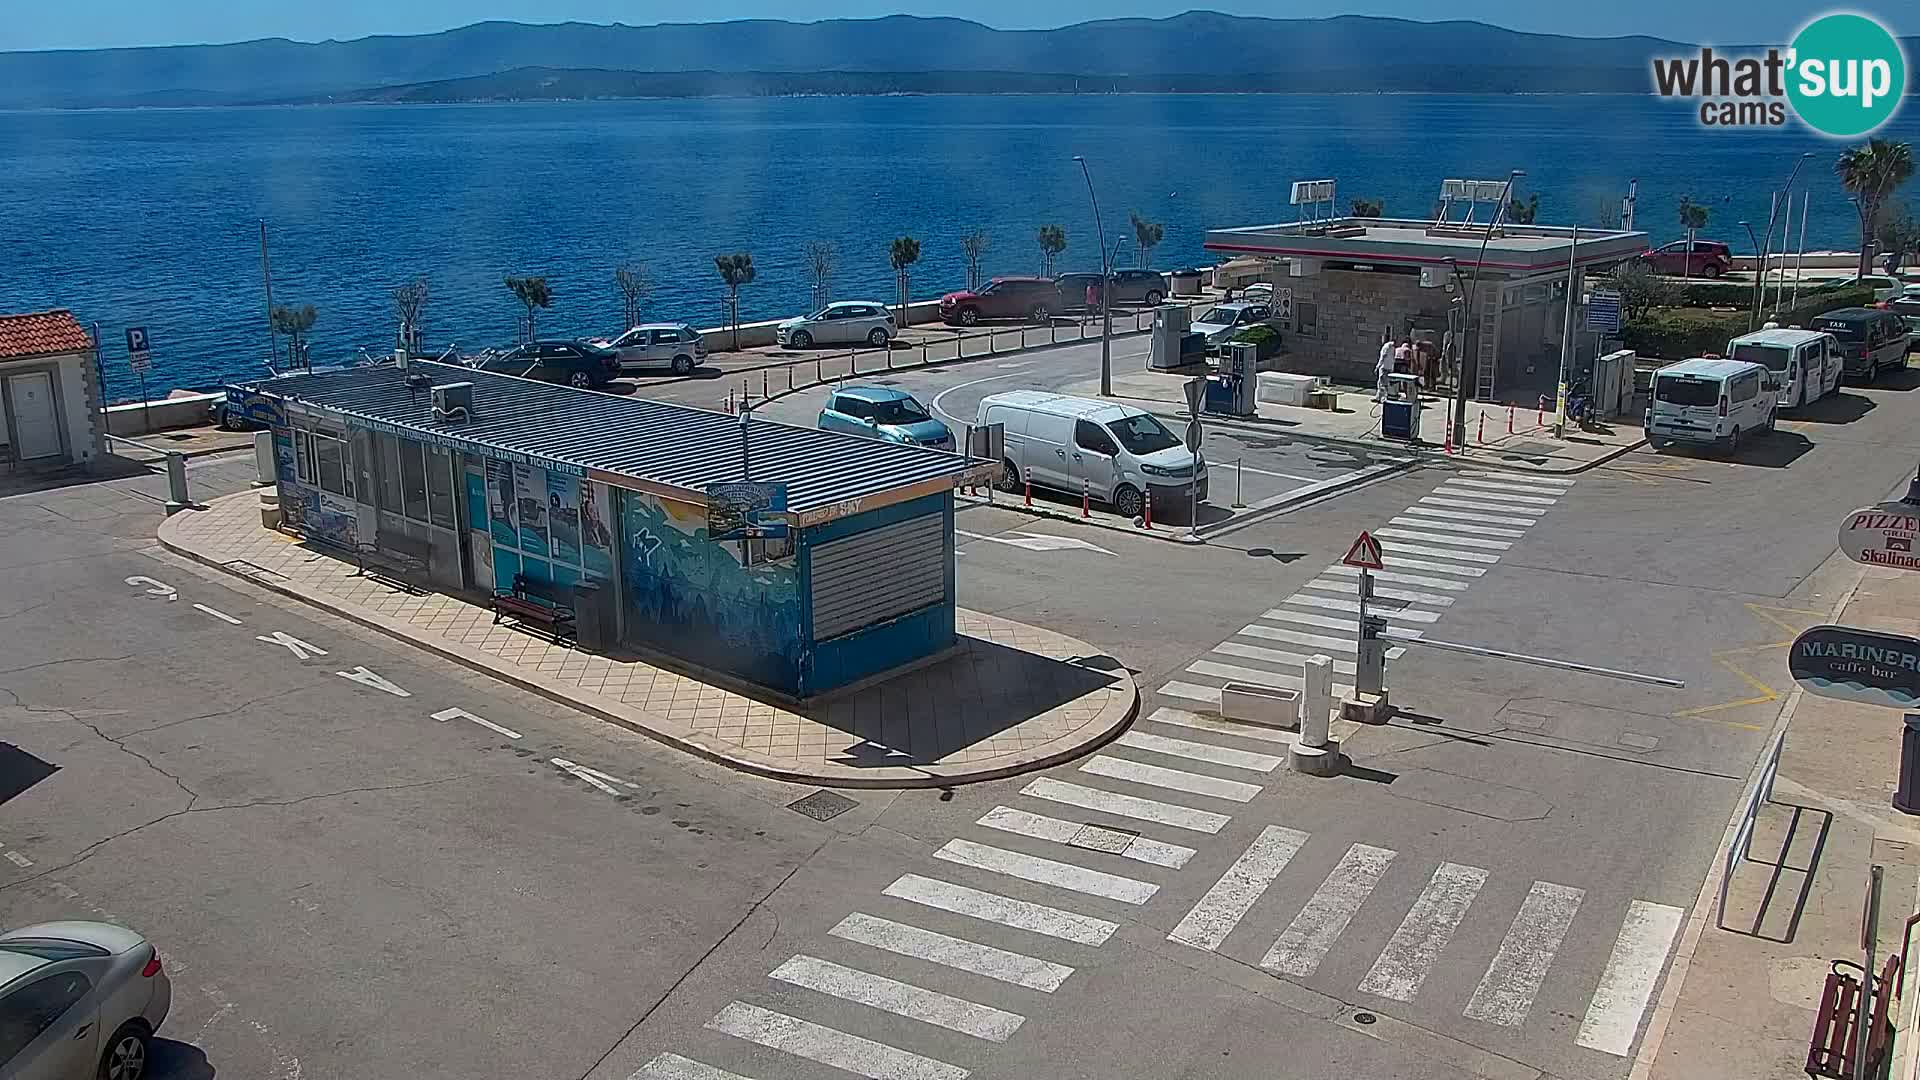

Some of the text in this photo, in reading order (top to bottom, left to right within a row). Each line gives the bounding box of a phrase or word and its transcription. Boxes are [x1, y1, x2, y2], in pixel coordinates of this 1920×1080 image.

[1828, 320, 1846, 329] TAXI
[131, 330, 143, 349] P
[437, 434, 469, 450] POSTAJA
[480, 446, 494, 457] BUS
[495, 449, 527, 464] STATION
[529, 457, 554, 471] TICKET
[556, 462, 583, 476] OFFICE
[1849, 514, 1920, 532] PIZZE
[1830, 662, 1898, 680] caffe bar
